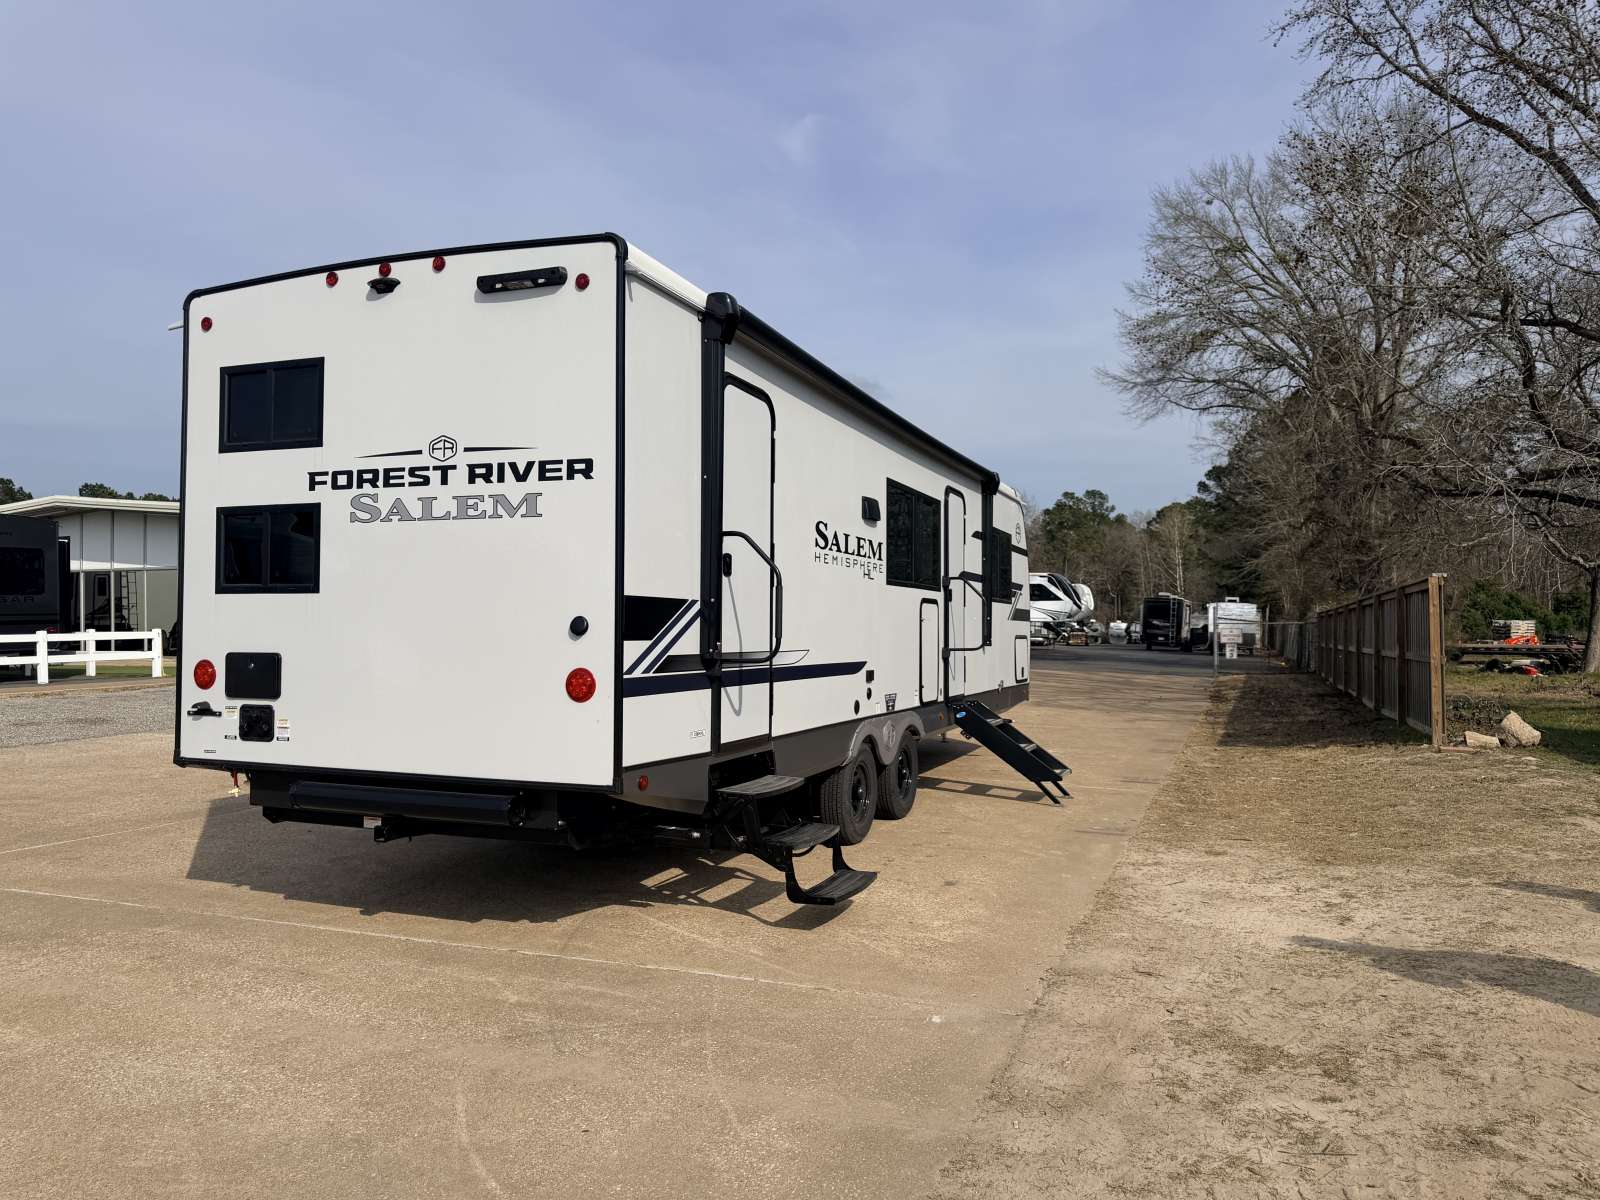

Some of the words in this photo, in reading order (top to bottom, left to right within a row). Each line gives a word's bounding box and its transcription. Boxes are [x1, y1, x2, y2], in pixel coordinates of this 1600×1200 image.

[307, 464, 457, 491] FOREST
[466, 458, 595, 484] RIVER
[349, 492, 543, 523] SALEM
[815, 520, 883, 561] SALEM
[814, 551, 884, 573] HEMISPHERE
